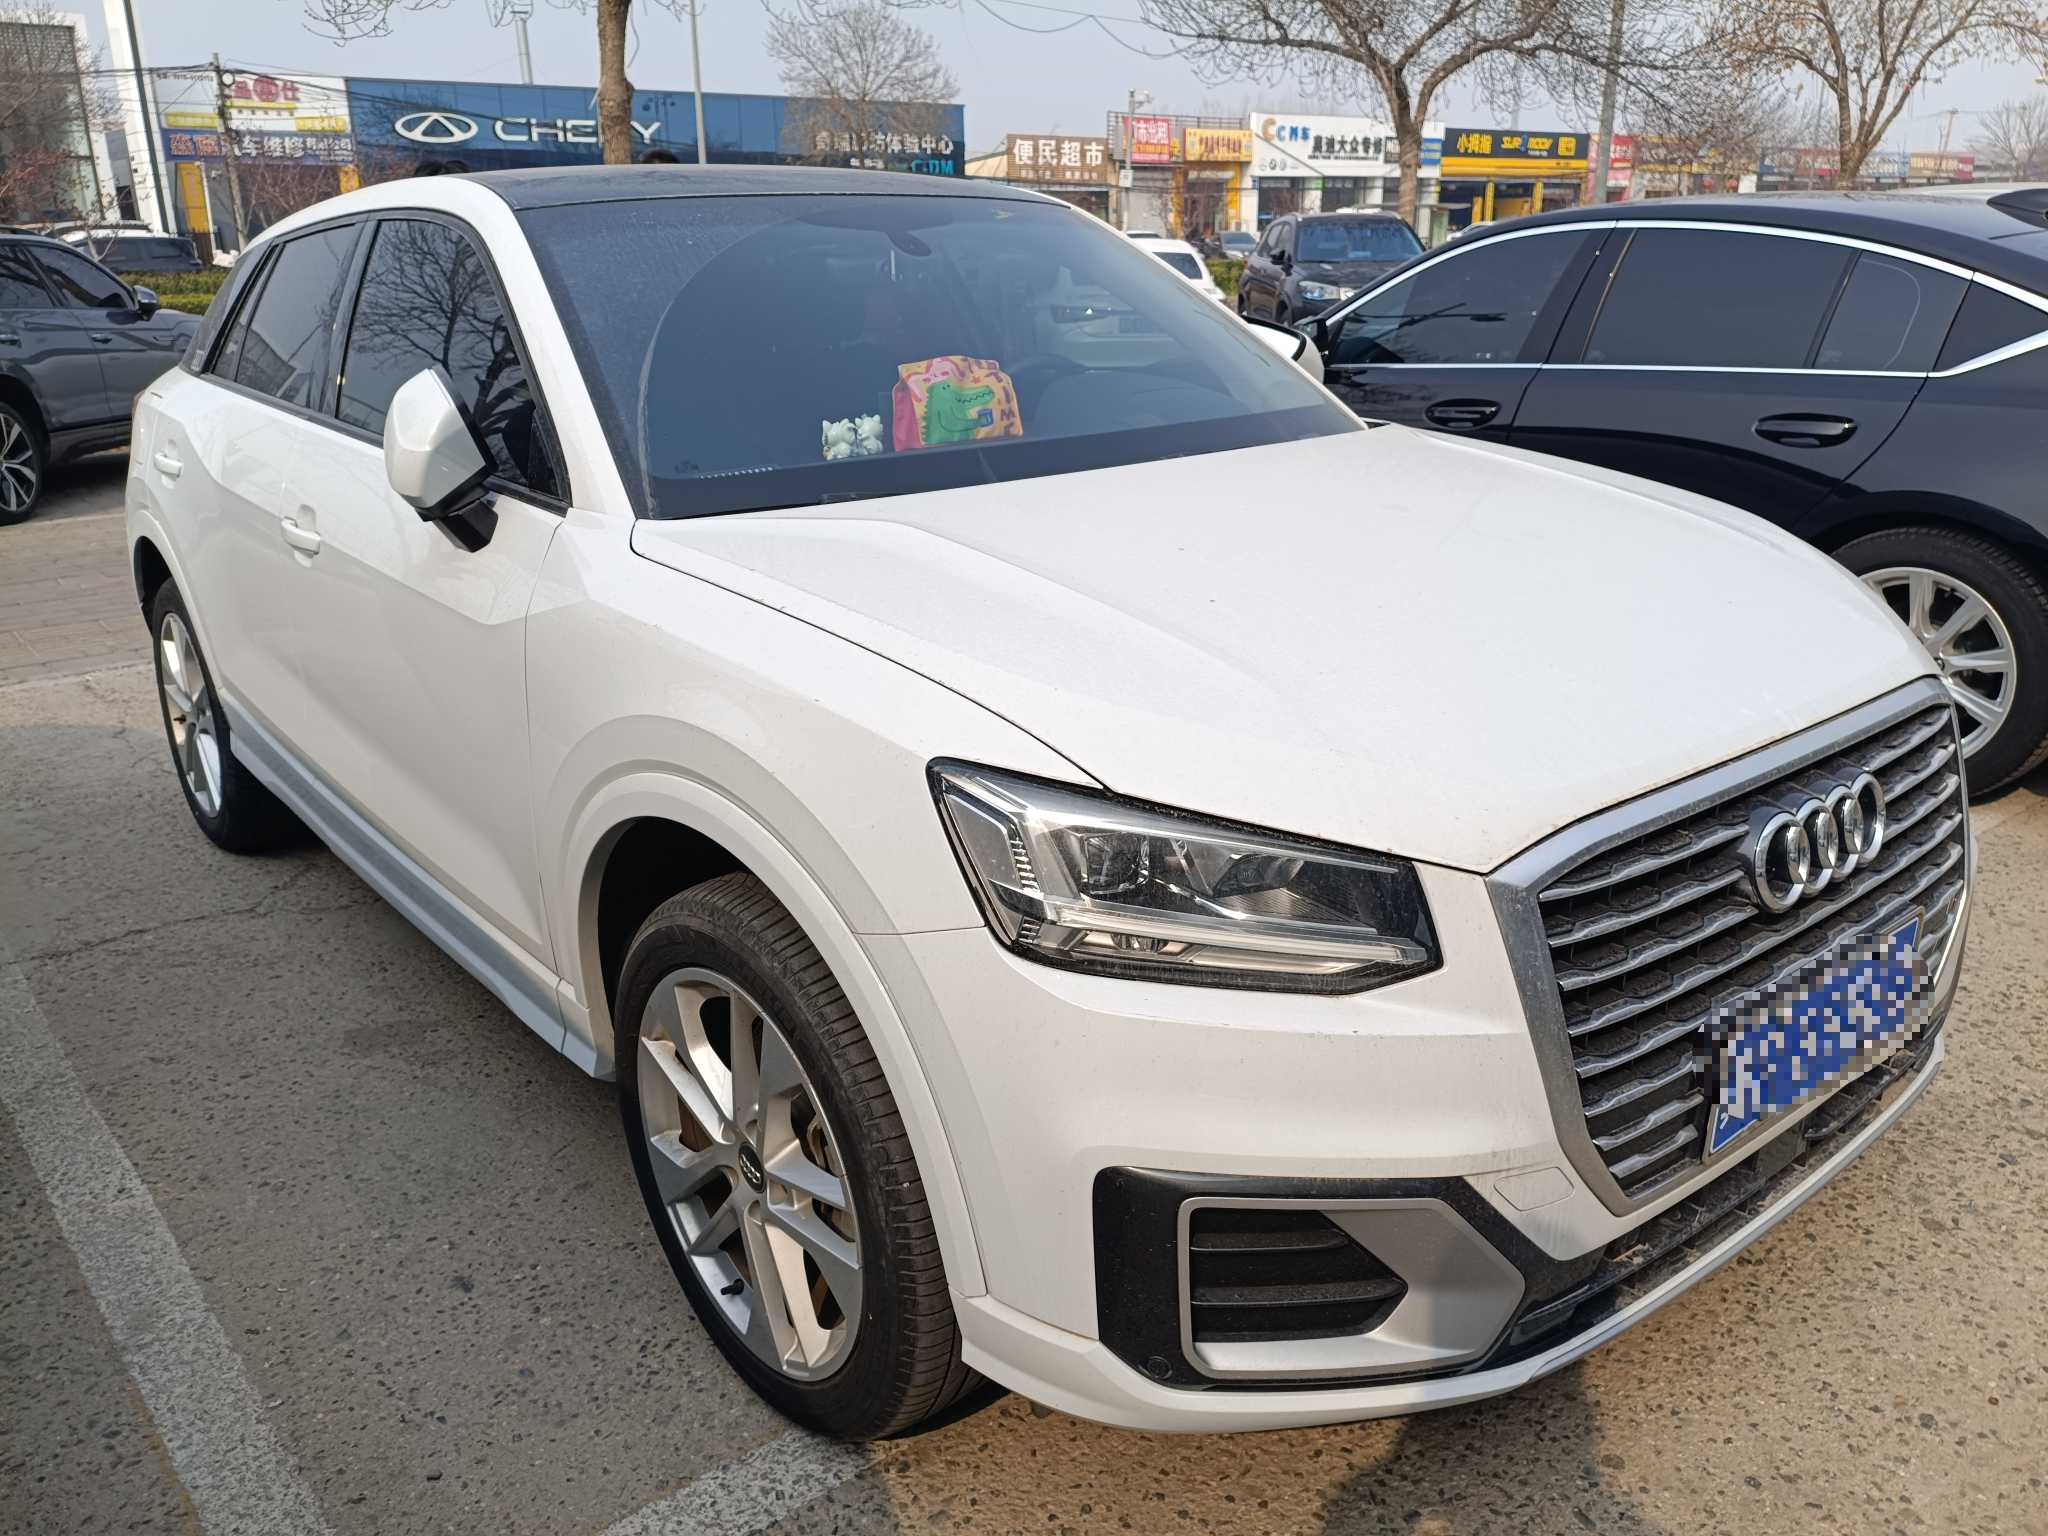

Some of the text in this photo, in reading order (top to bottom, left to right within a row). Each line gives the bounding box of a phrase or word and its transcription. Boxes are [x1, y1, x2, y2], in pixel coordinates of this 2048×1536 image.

[494, 117, 661, 145] CHEY
[1013, 138, 1104, 167] 便民超市
